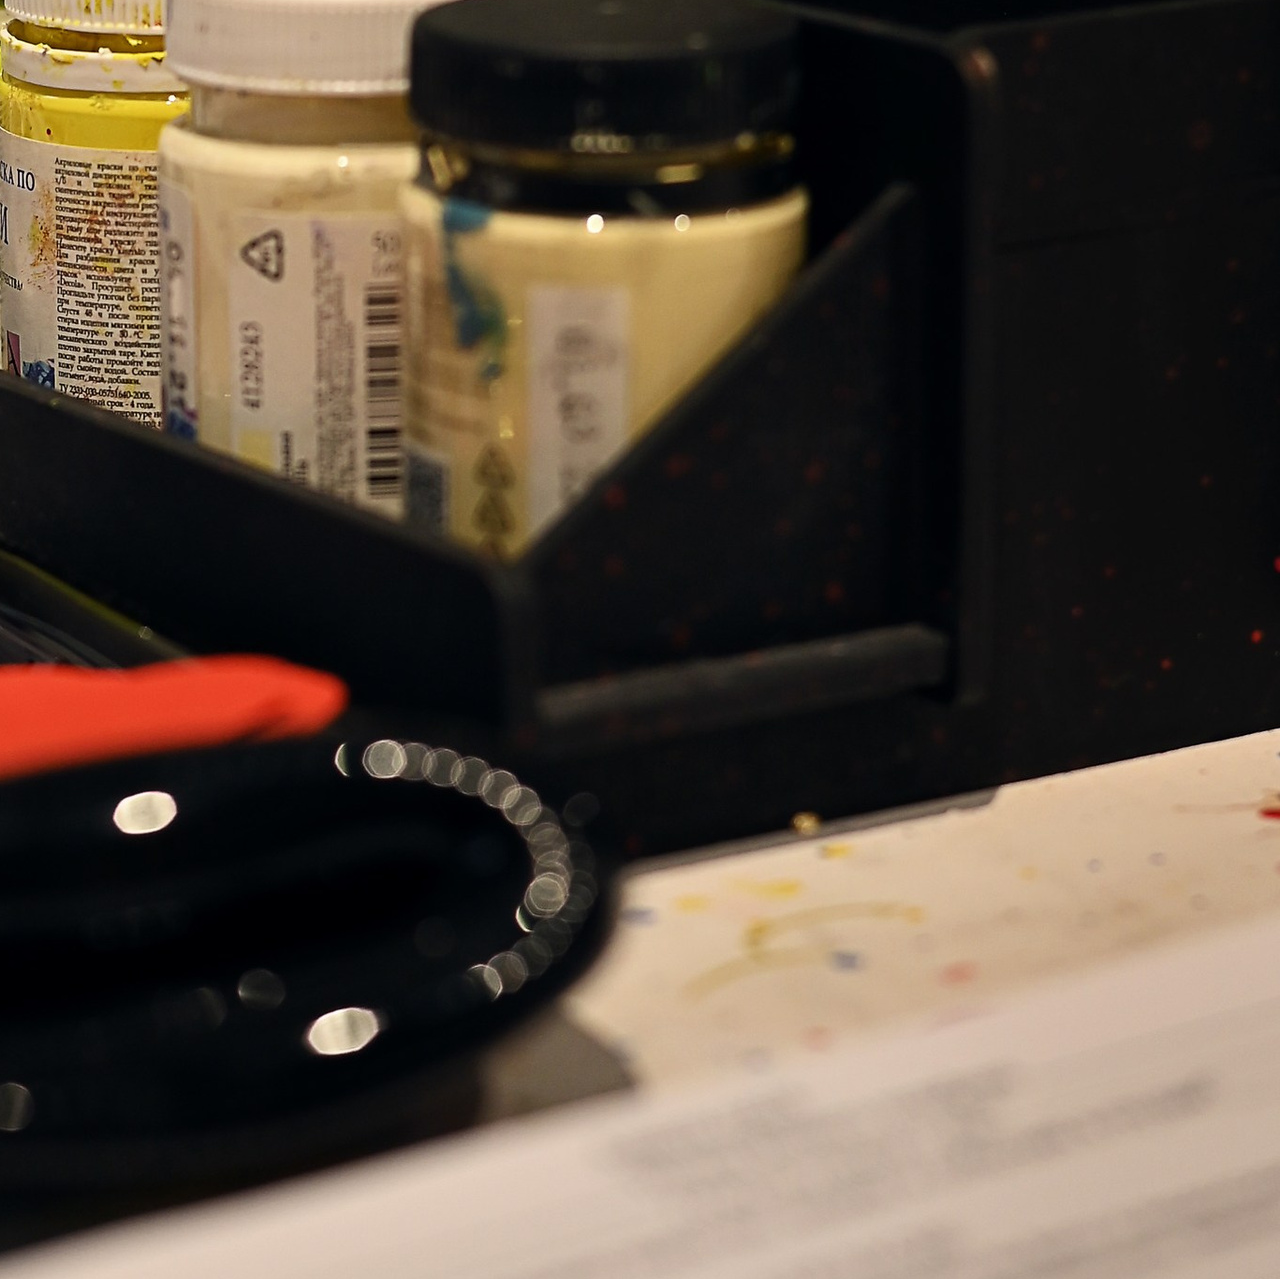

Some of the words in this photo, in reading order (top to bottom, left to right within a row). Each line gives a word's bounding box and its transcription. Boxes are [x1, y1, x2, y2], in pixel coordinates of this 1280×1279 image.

[97, 163, 123, 171] краски
[17, 168, 35, 191] ПО
[90, 246, 113, 255] краску
[97, 293, 125, 302] утюгом
[58, 305, 79, 316] Спустя
[58, 344, 80, 353] плотно
[83, 347, 116, 356] закрытой
[119, 350, 137, 358] таре.
[58, 352, 76, 361] после
[79, 355, 103, 364] работы
[107, 357, 143, 367] промойте
[58, 361, 73, 371] кожу
[77, 363, 101, 373] смойте
[130, 400, 134, 408] 4
